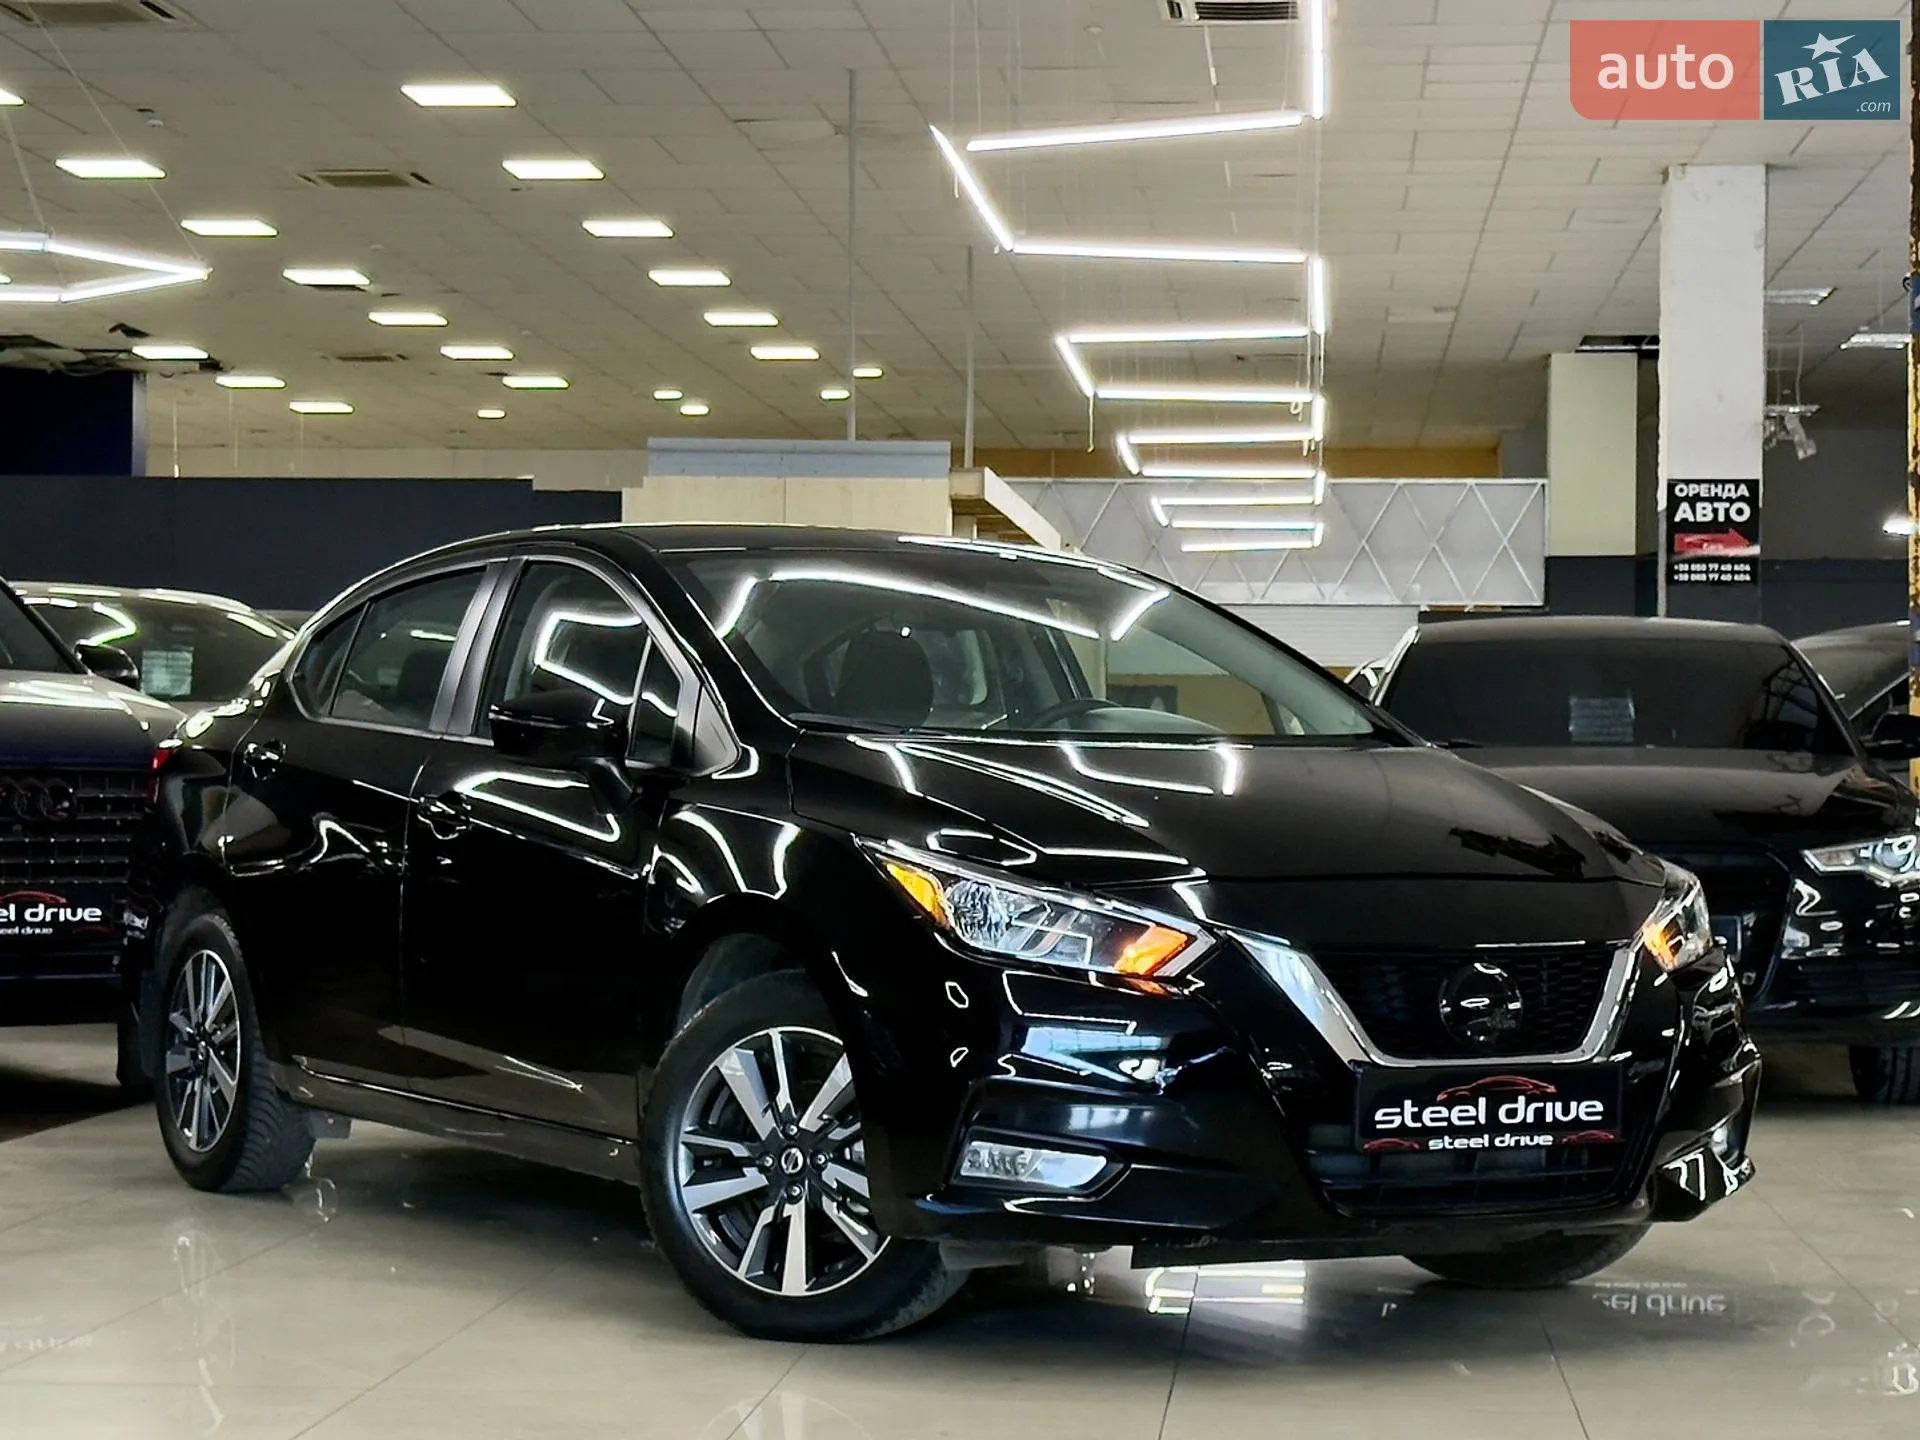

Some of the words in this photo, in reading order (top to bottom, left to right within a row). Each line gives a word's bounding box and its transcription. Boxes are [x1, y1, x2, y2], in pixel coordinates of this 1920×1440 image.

[1674, 483, 1750, 499] ОРЕНДА
[1674, 501, 1751, 523] АВТО
[24, 903, 102, 922] drive
[1374, 1096, 1486, 1130] steel
[1498, 1095, 1604, 1124] drive
[1428, 1134, 1489, 1151] steel
[1494, 1133, 1554, 1147] drive
